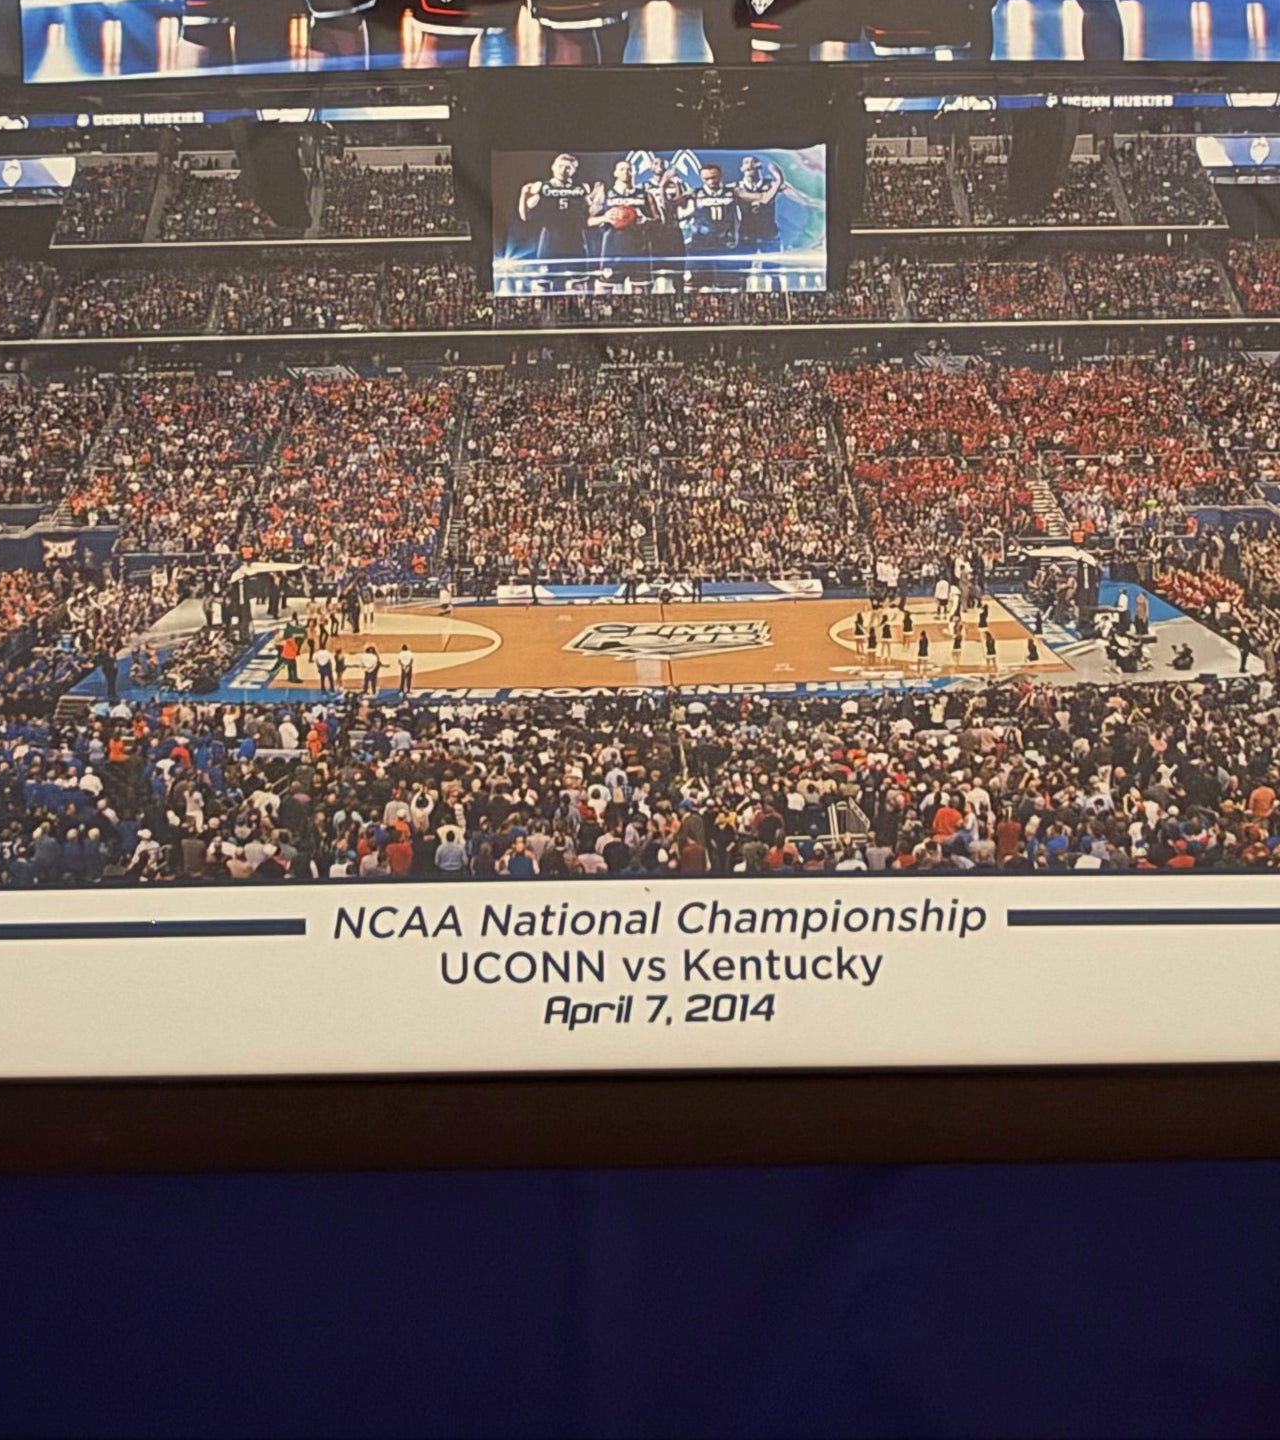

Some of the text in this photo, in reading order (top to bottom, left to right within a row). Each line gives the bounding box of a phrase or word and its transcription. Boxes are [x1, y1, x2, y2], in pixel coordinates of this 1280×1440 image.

[407, 688, 499, 699] THE
[333, 898, 987, 940] NCAA National Championship
[440, 946, 884, 987] UCONN vs Kentucky
[543, 993, 776, 1031] April 7, 2014
